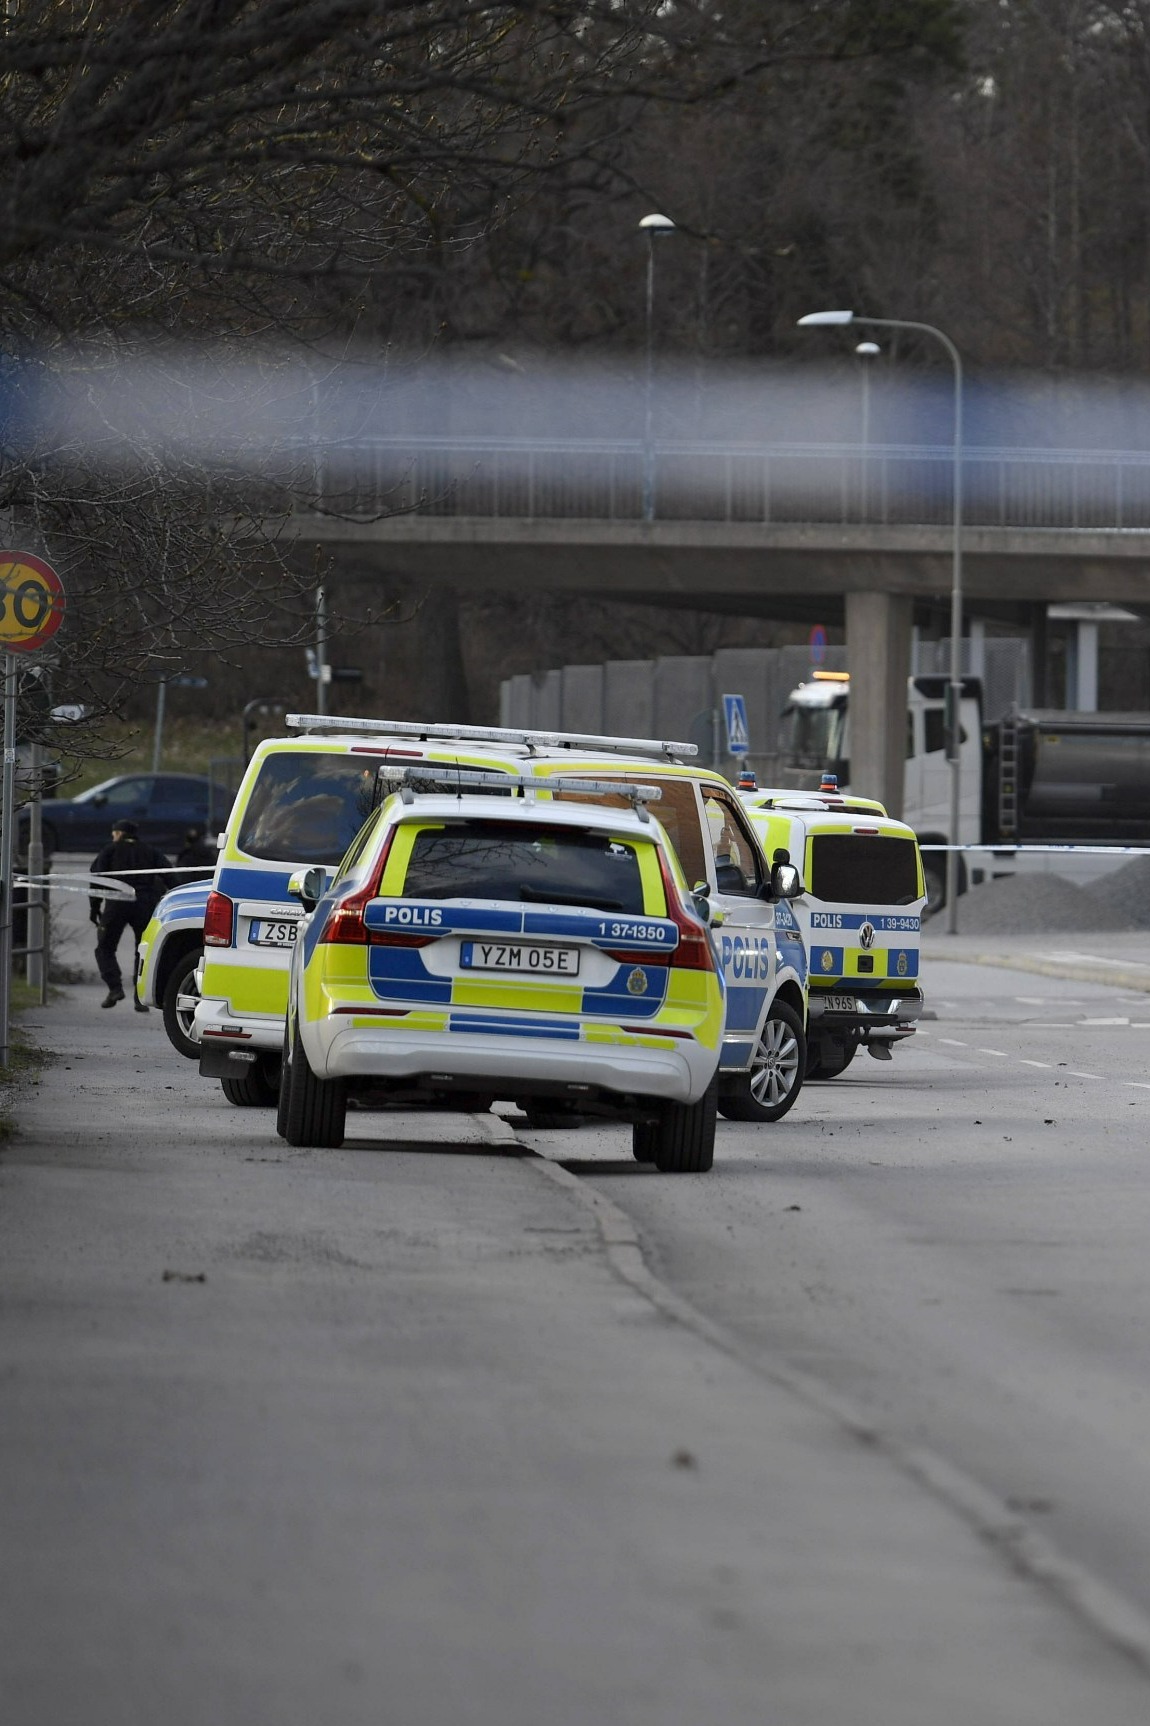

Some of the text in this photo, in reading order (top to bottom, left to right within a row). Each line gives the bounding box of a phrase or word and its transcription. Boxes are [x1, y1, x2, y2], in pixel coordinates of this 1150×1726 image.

[0, 579, 48, 629] 0
[385, 906, 443, 926] POLIS
[813, 913, 842, 928] POLIS
[880, 918, 920, 930] 1 39-9430
[265, 923, 299, 942] ZSB
[599, 922, 666, 941] 1 37-1350
[481, 945, 569, 970] YZM 05E
[721, 935, 769, 980] POLIS
[835, 997, 852, 1009] 96S
